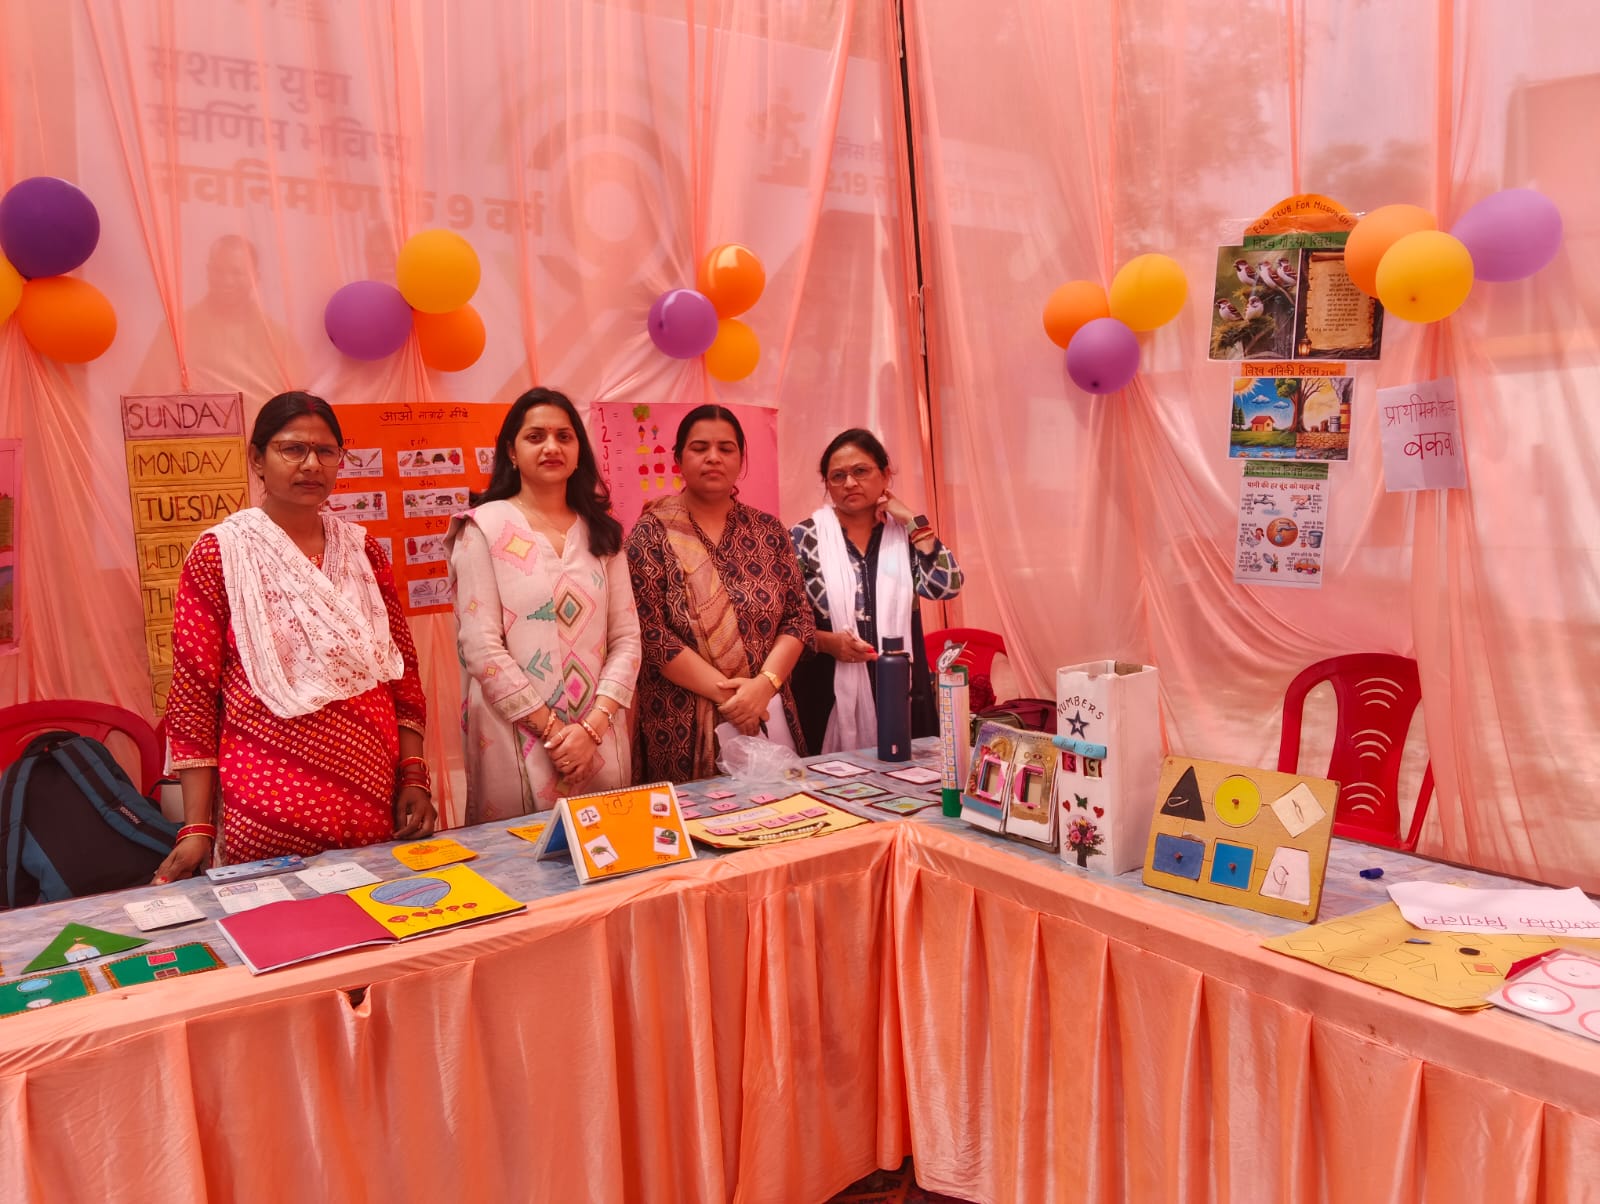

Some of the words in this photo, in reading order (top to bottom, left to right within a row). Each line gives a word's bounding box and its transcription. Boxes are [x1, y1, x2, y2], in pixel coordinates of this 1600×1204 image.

[446, 194, 474, 229] 9
[1253, 217, 1271, 234] ECO
[1272, 204, 1293, 224] CLUB
[1295, 200, 1311, 211] FOR
[1298, 364, 1319, 376] दिवस
[127, 400, 237, 431] SUNDAY
[601, 426, 611, 443] 2
[138, 448, 232, 477] MONDAY
[140, 492, 246, 522] TUESDAY
[144, 543, 190, 570] WEDN
[143, 588, 176, 615] TH
[1057, 695, 1105, 721] NUMBERS
